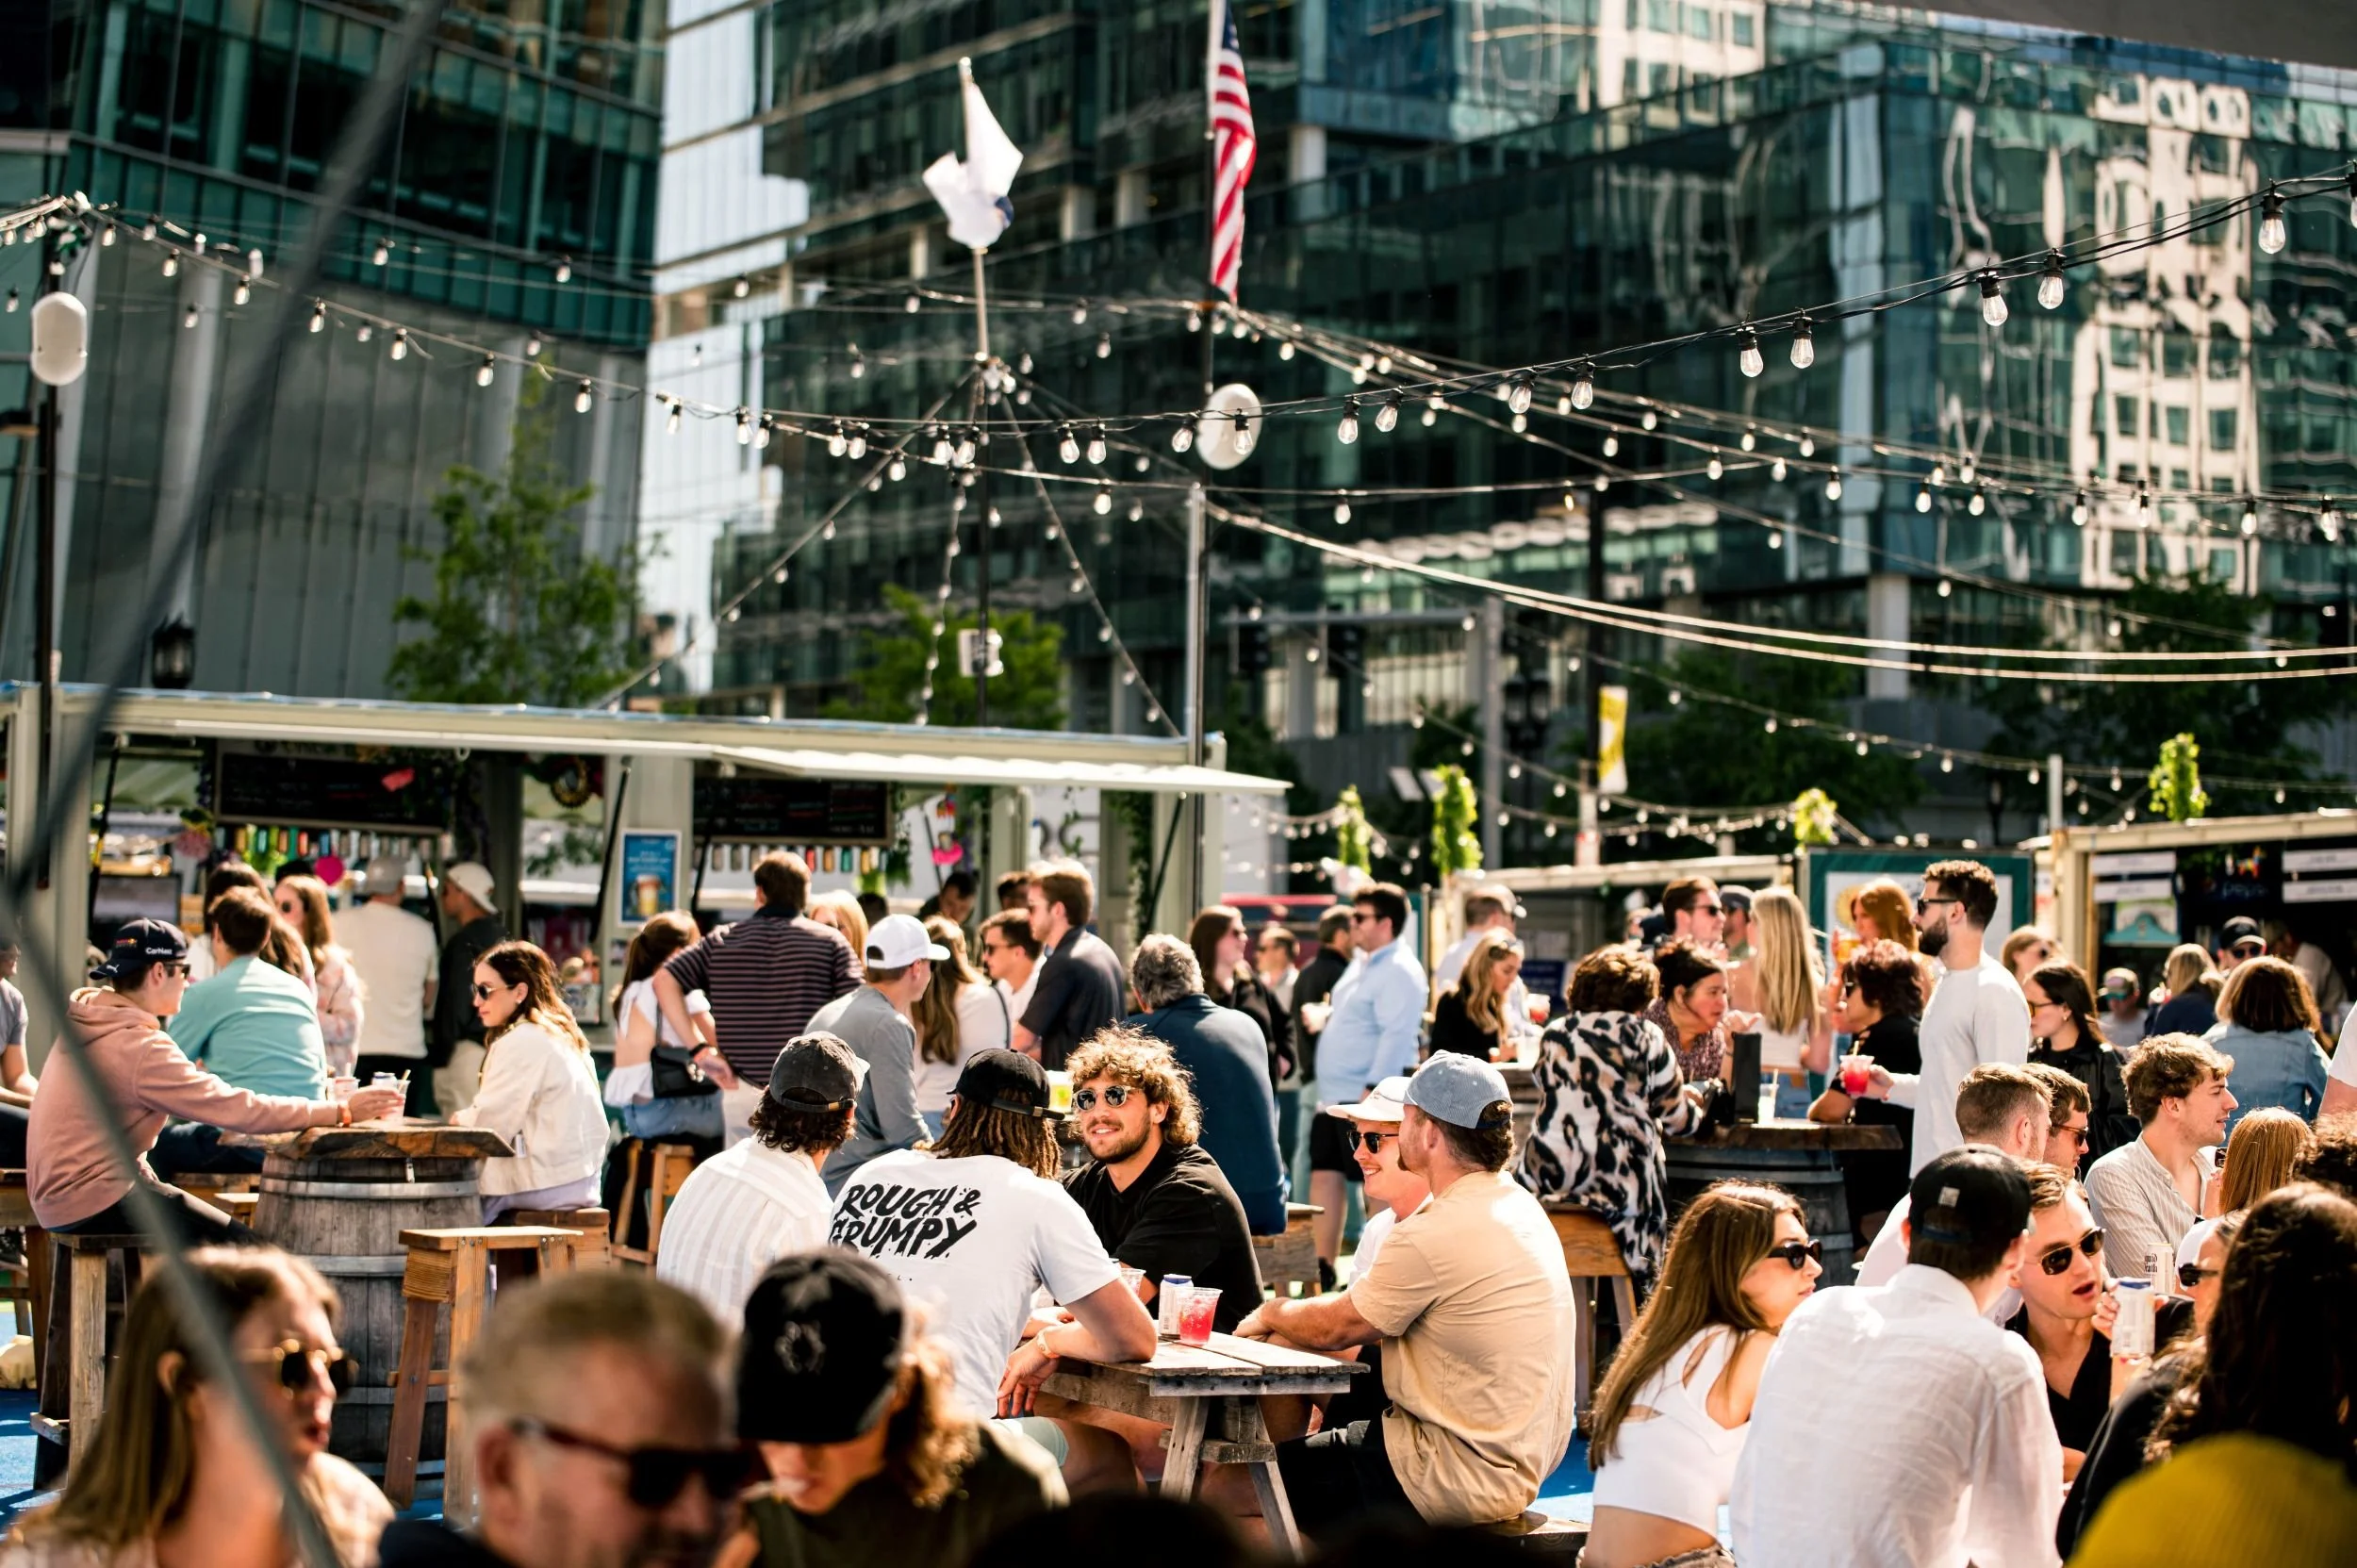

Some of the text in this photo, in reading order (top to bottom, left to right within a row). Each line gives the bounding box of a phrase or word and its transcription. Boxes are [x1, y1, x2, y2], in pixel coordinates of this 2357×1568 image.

[833, 1183, 981, 1221] ROUGH &
[829, 1216, 978, 1259] GRUMPY
